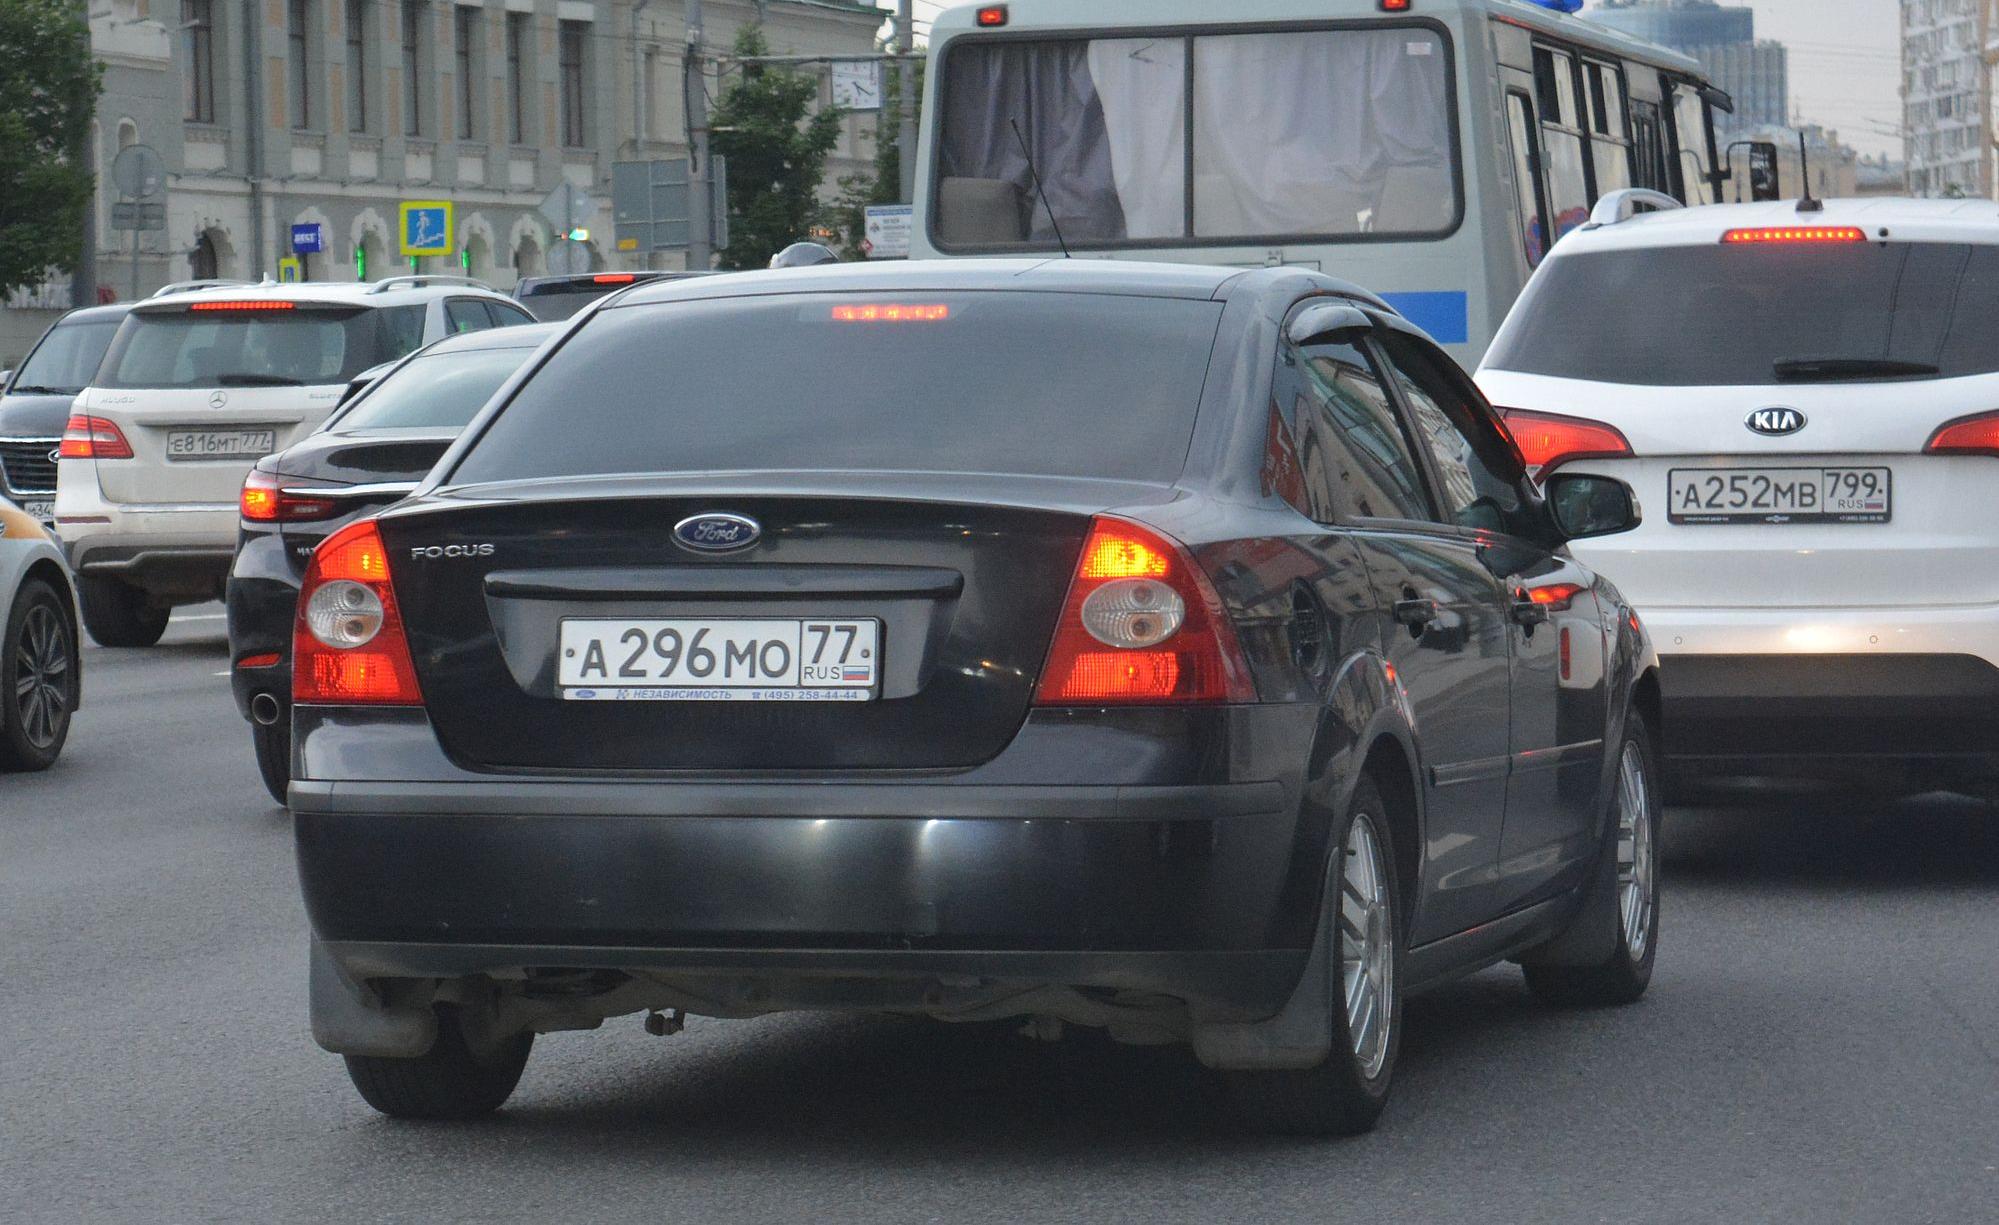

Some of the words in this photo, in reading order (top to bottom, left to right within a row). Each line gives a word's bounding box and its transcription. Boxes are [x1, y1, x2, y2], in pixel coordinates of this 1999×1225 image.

[1754, 411, 1798, 430] KIA
[1682, 475, 1817, 509] А252МВ
[1826, 472, 1878, 498] 799
[1838, 499, 1864, 509] RUS
[694, 520, 739, 541] Ford
[411, 543, 495, 560] FOCUS
[579, 627, 791, 678] А296МО
[807, 625, 858, 664] 77
[803, 666, 840, 680] RUS
[633, 689, 733, 699] НЕЗАВИСИМОСТЬ
[764, 690, 795, 700] (495)
[799, 691, 858, 699] 258-44-44
